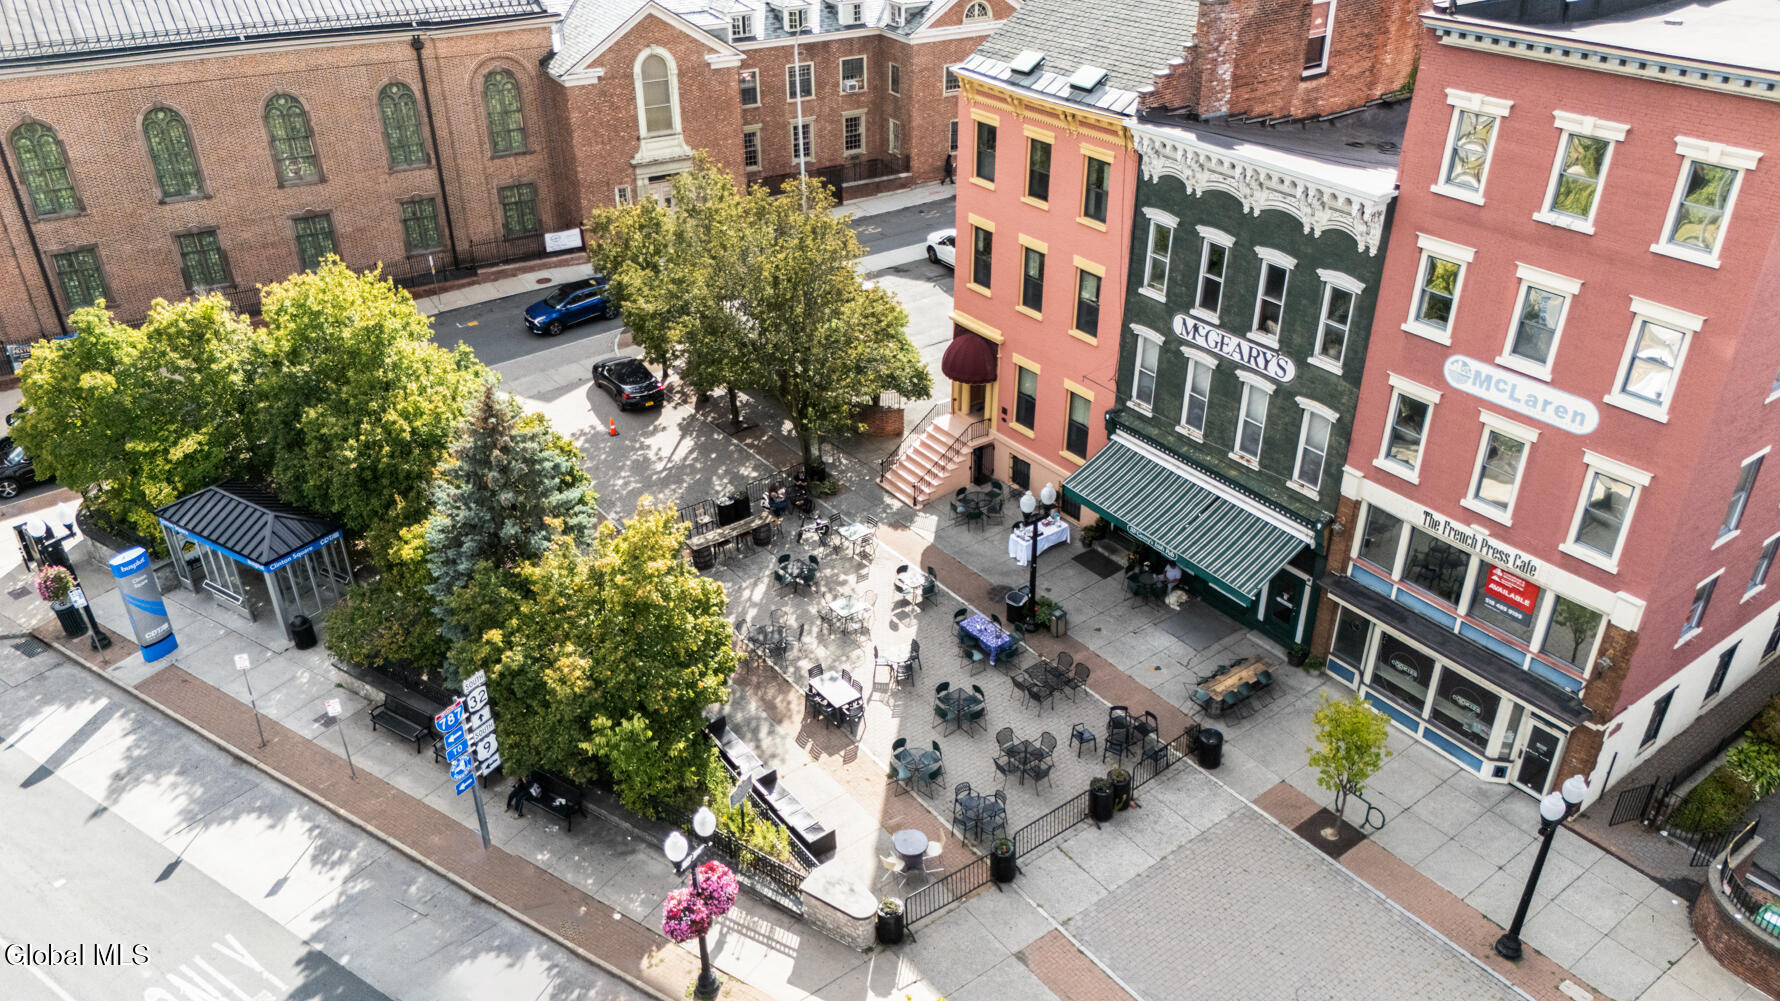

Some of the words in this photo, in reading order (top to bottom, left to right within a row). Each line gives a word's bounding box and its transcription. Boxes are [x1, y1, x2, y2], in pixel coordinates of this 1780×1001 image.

[1472, 369, 1587, 428] McLaren
[1423, 510, 1441, 532] The
[1442, 519, 1478, 550] French
[1480, 537, 1511, 565] Press
[1512, 553, 1537, 577] Cafe
[269, 557, 292, 570] Clinton
[292, 546, 314, 559] Square
[1488, 583, 1530, 607] AVAILABLE
[465, 674, 484, 691] SOUTH
[470, 689, 487, 709] 32
[439, 706, 462, 730] 787
[475, 721, 493, 739] SOUTH
[453, 744, 463, 755] TO
[483, 741, 491, 754] 9
